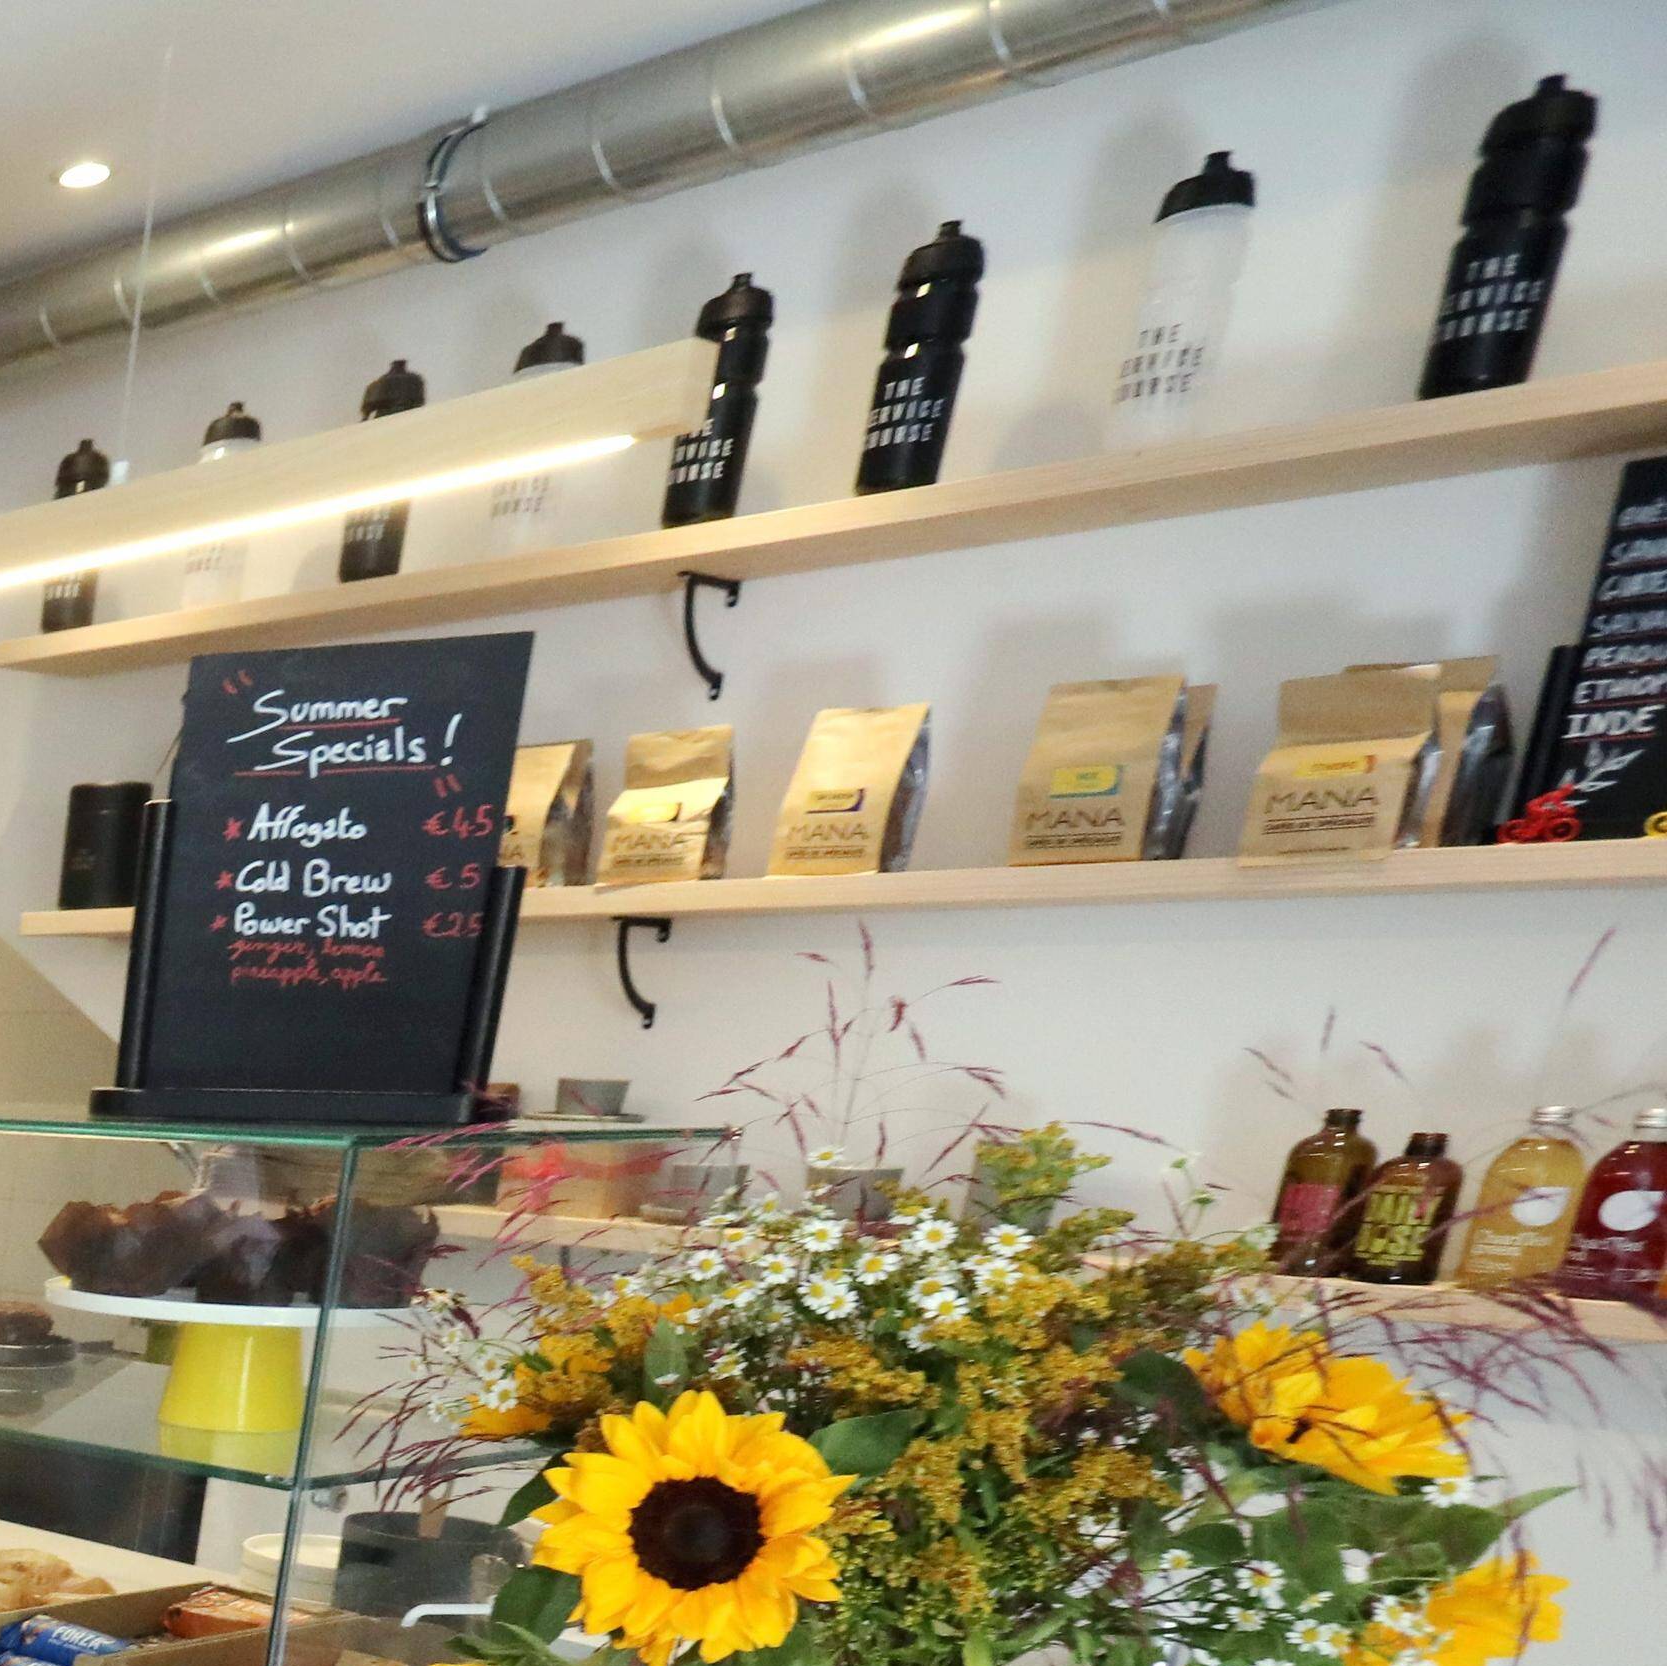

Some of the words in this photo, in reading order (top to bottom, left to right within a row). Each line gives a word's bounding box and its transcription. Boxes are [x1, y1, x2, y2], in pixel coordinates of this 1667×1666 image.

[1467, 253, 1520, 283] THE
[1441, 280, 1545, 317] ERVICE
[1439, 308, 1533, 341] OURSE
[884, 376, 926, 401] THE
[868, 398, 945, 428] ERVICE
[867, 423, 934, 449] OURSE
[226, 688, 409, 743] Summer
[1562, 704, 1657, 739] INDE
[1264, 786, 1379, 815] MANA
[247, 802, 367, 848] Affogato
[786, 822, 870, 843] MANA
[1025, 807, 1125, 831] MANA
[235, 860, 291, 894] Cold
[302, 858, 392, 898] Brew
[234, 901, 311, 936] Power
[316, 904, 393, 939] Shot
[51, 1625, 107, 1650] FORZA
